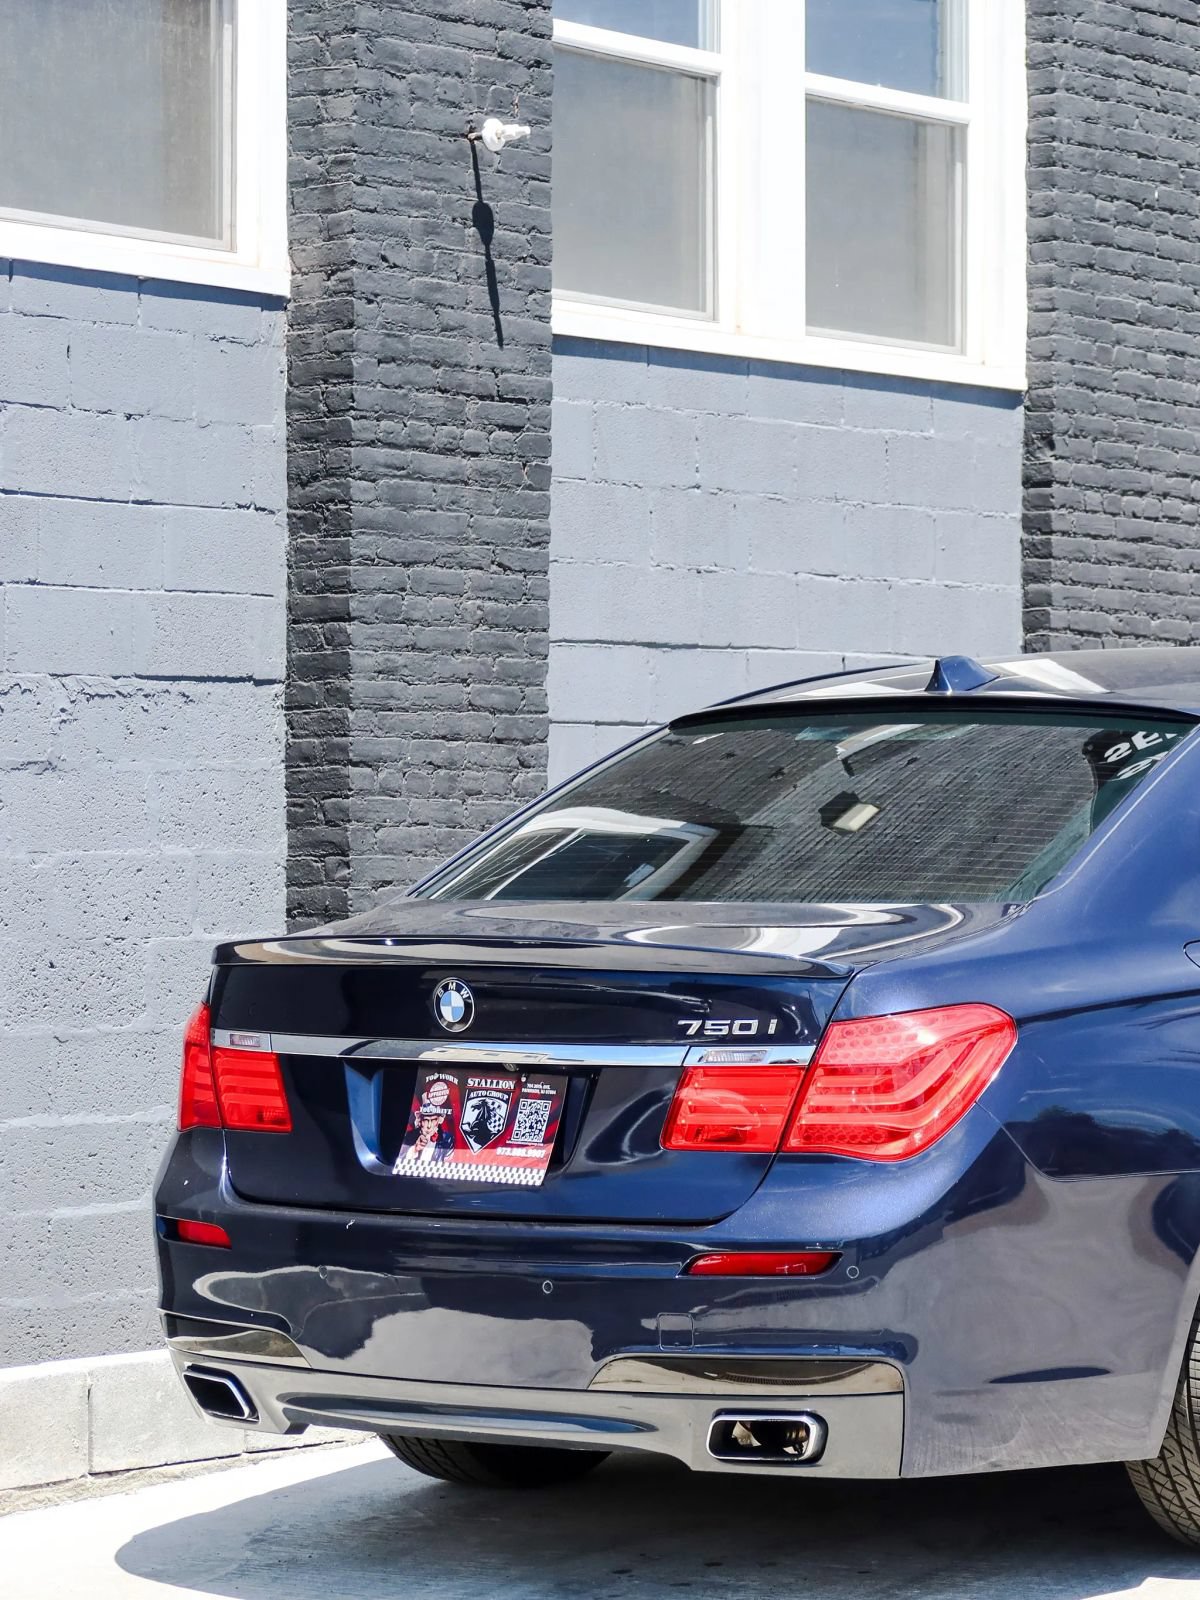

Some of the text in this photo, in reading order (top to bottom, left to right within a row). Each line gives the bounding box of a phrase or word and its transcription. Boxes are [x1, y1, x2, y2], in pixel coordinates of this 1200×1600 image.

[467, 1077, 516, 1089] STALLION
[469, 1090, 509, 1100] AUTO GROUP
